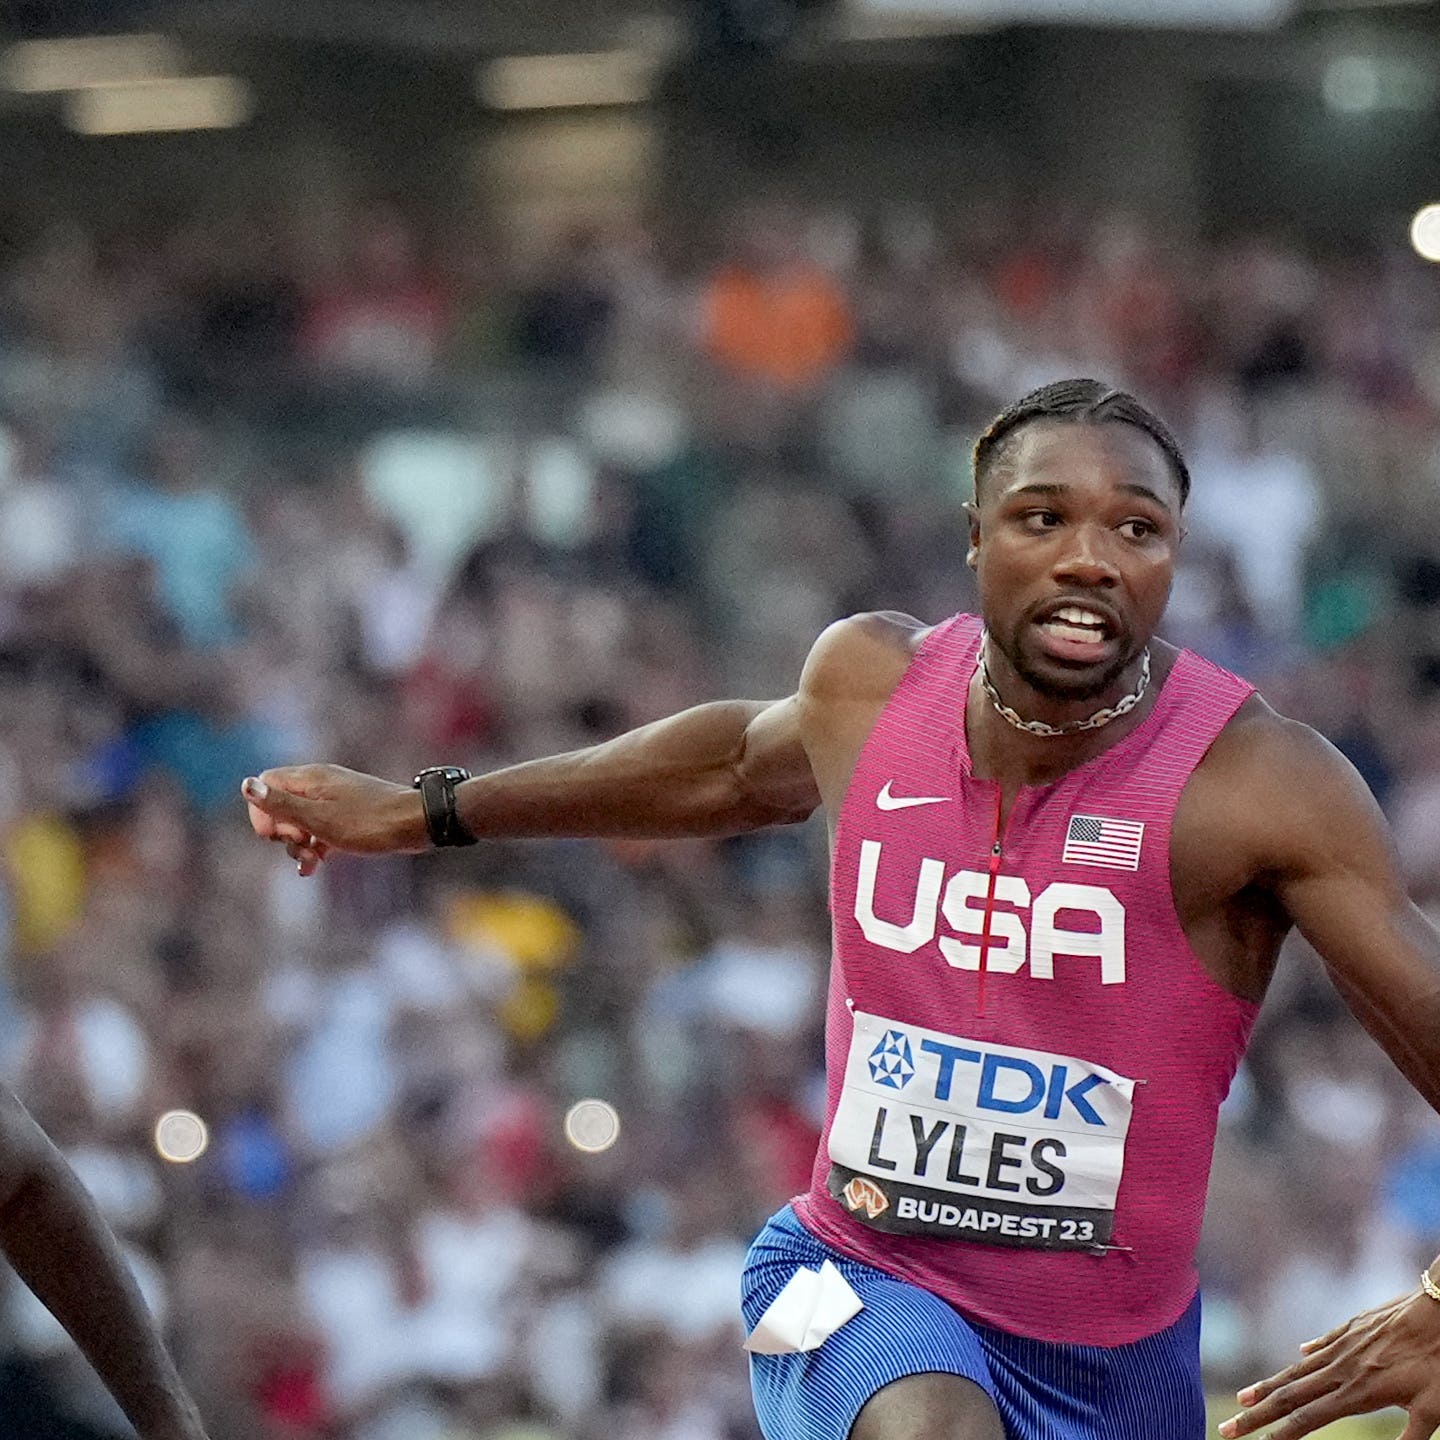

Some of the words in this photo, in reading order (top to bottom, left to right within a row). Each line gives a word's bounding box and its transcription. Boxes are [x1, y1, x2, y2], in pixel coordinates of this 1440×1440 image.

[854, 840, 1126, 985] USA
[920, 1039, 1112, 1126] TDK
[867, 1107, 1067, 1197] LYLES
[897, 1197, 1058, 1240] BUDAPEST
[1060, 1218, 1095, 1241] 23
